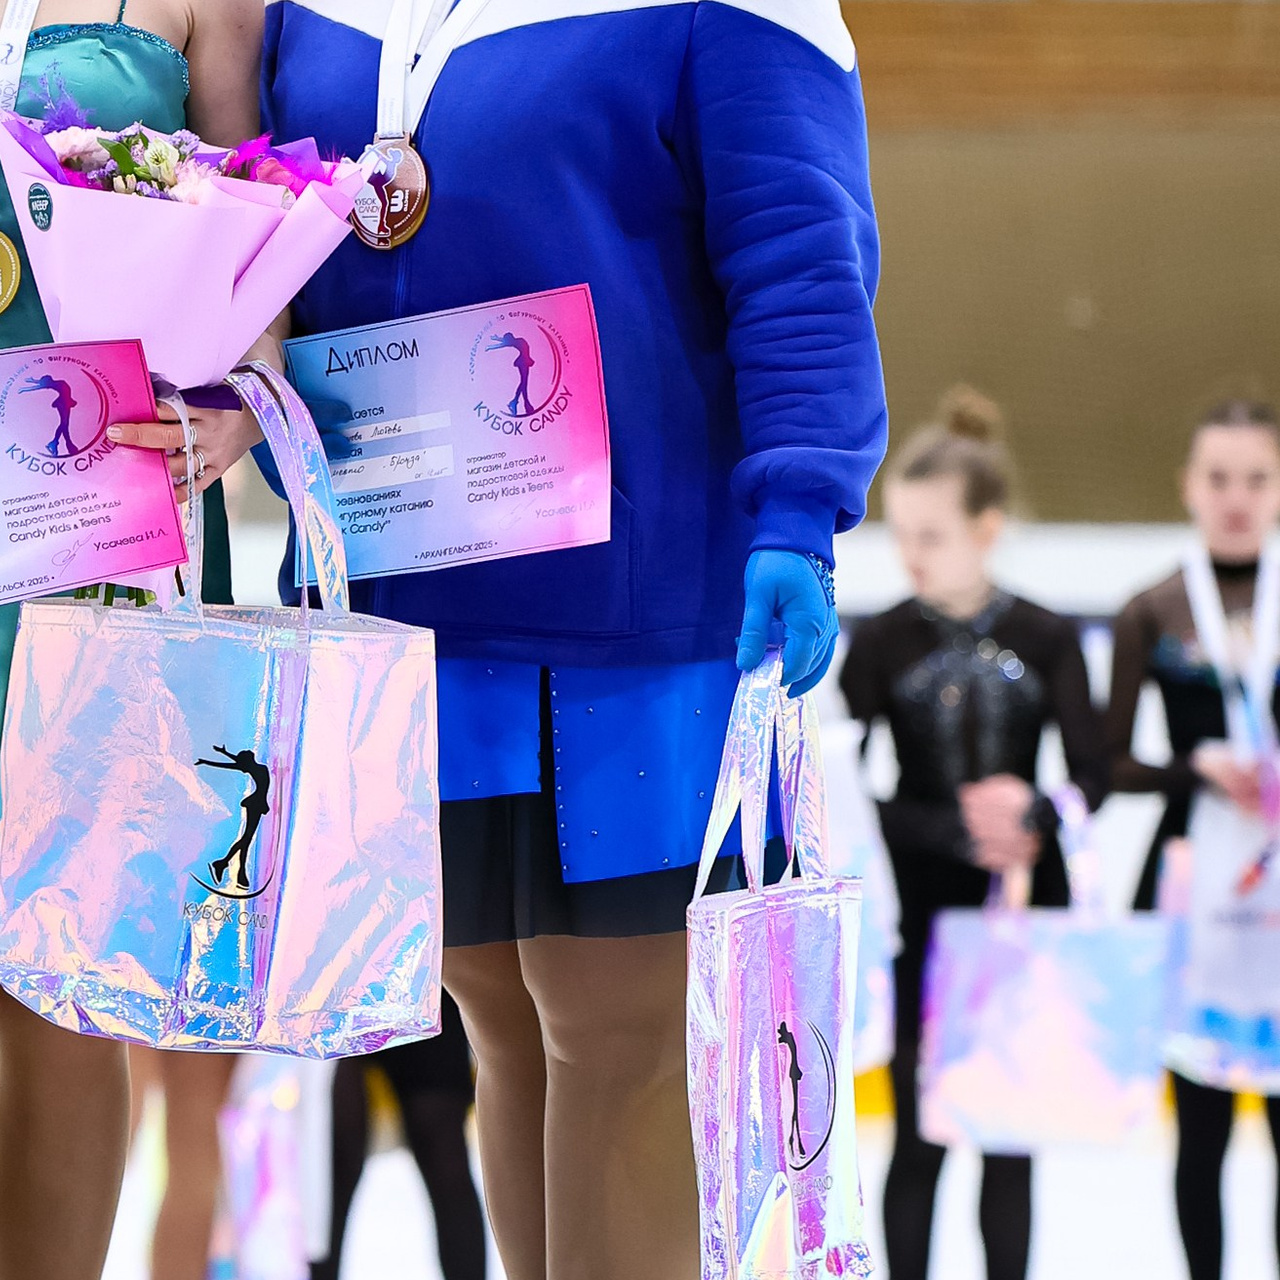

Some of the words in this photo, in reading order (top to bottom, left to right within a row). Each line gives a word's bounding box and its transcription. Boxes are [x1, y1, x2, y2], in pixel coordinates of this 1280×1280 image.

[390, 190, 404, 212] 3
[473, 401, 523, 436] КУБОК
[529, 385, 573, 432] CANDY
[5, 443, 67, 476] КУБОК
[467, 463, 502, 476] магазин
[503, 457, 539, 471] детской
[540, 455, 547, 463] и
[467, 470, 528, 489] подростковой
[529, 465, 565, 478] одежды
[467, 489, 501, 504] Candy
[501, 485, 520, 497] Kids
[527, 479, 555, 493] Teens
[4, 502, 46, 517] магазин
[48, 493, 88, 510] детской
[91, 492, 98, 500] и
[6, 507, 80, 529] подростковой
[82, 499, 122, 515] одежды
[389, 499, 434, 514] катанию
[8, 528, 47, 543] Candy
[49, 522, 71, 535] Kids
[78, 515, 112, 529] Teens
[93, 534, 144, 552] Усачева
[420, 544, 474, 560] АРХАНГЕЛЬСК
[474, 540, 493, 552] 2025
[26, 574, 50, 587] 2025
[183, 901, 235, 923] КУБОК
